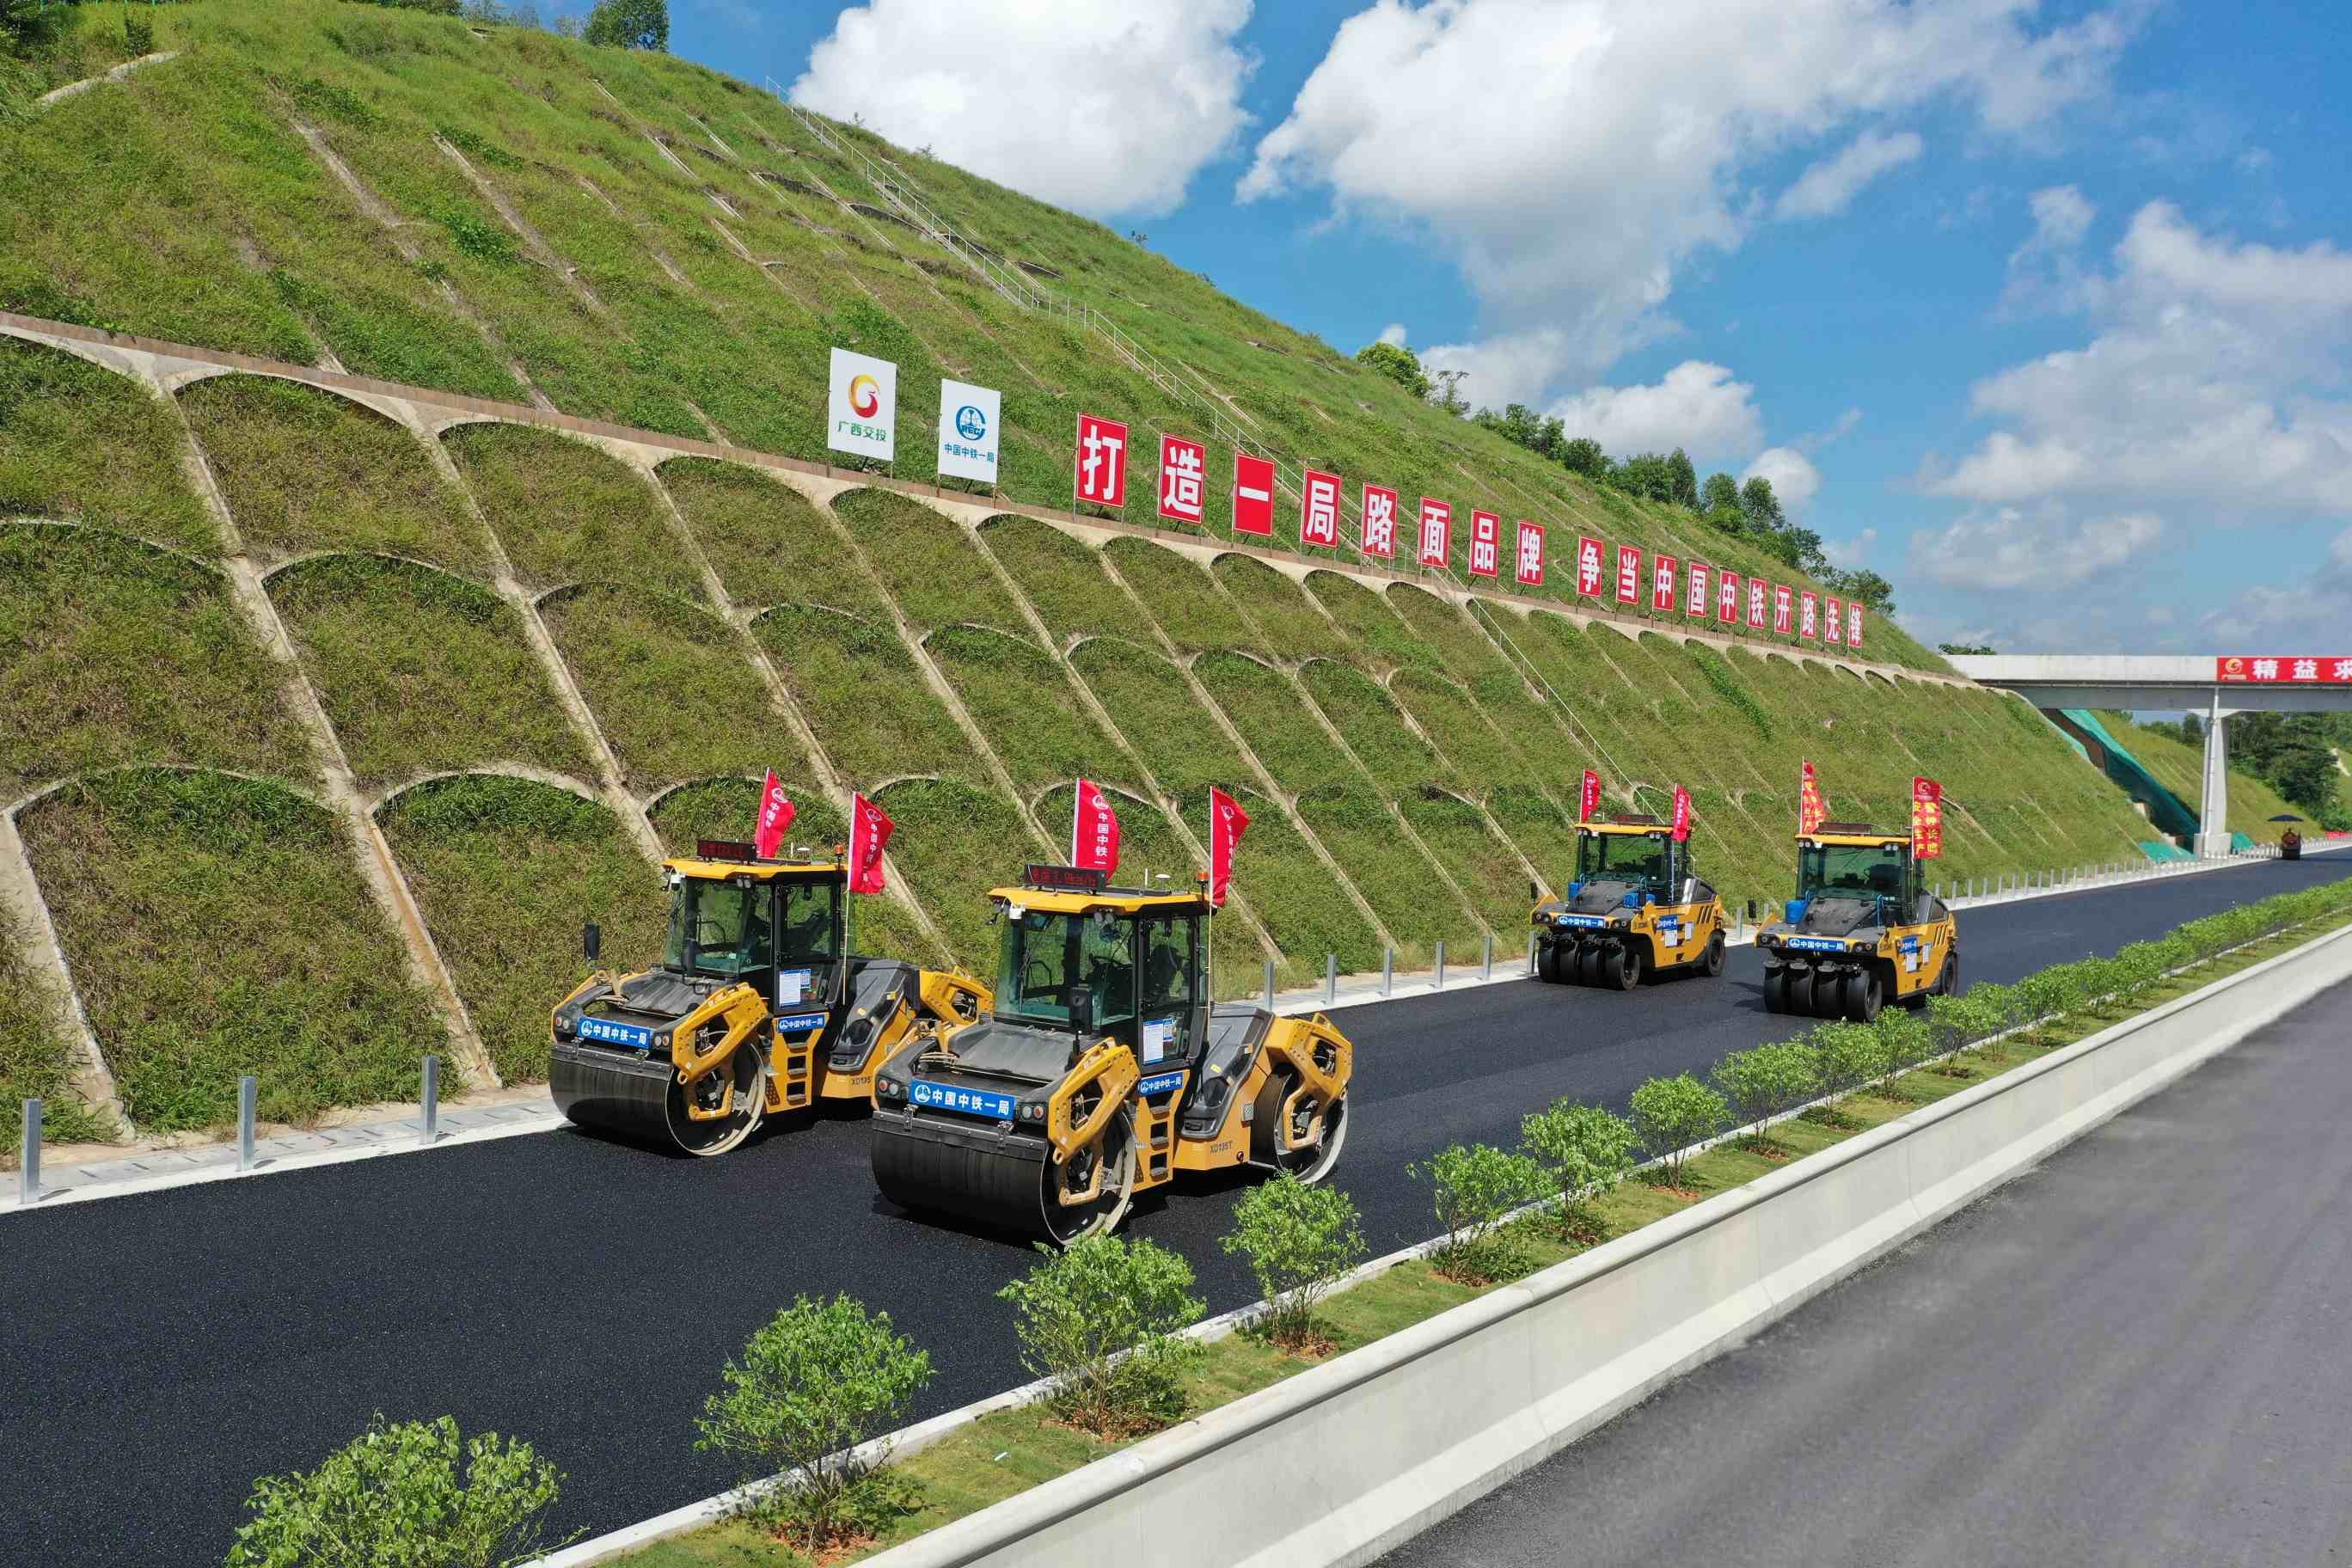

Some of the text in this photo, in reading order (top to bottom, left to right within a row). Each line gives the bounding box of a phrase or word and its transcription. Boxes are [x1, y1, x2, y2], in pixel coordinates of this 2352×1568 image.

[837, 420, 887, 443] 广西交投
[944, 443, 995, 463] 中国中铁一局
[1799, 940, 1845, 951] 中国中铁一局
[592, 1023, 647, 1045] 中国中铁一局
[931, 1088, 1010, 1116] 中国中铁一局
